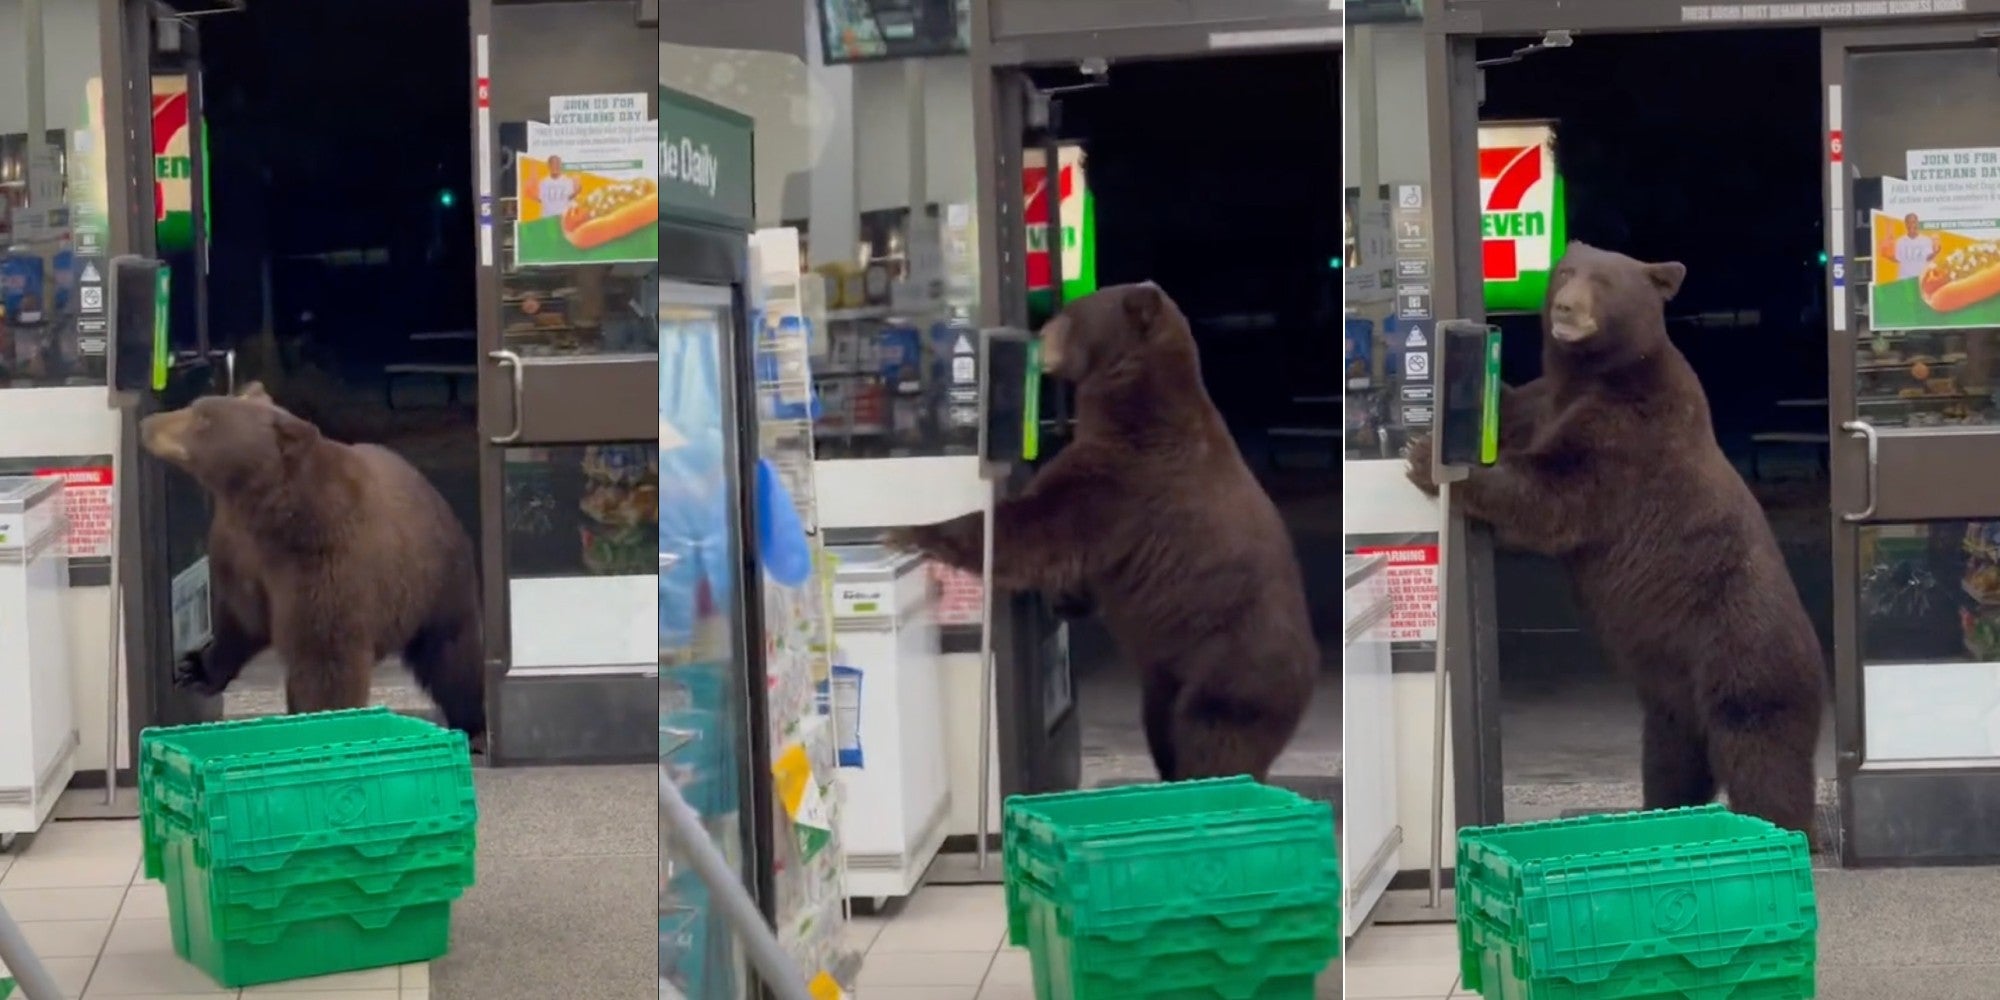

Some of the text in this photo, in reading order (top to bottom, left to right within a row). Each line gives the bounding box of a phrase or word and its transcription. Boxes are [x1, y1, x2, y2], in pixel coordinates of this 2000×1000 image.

[619, 111, 642, 122] DAY
[1830, 138, 1842, 153] 6
[681, 136, 718, 197] Daily
[1921, 152, 1998, 166] JOIN US FOR
[1911, 167, 1977, 181] VETERANS
[1481, 211, 1545, 237] EVEn
[1832, 263, 1844, 278] 5
